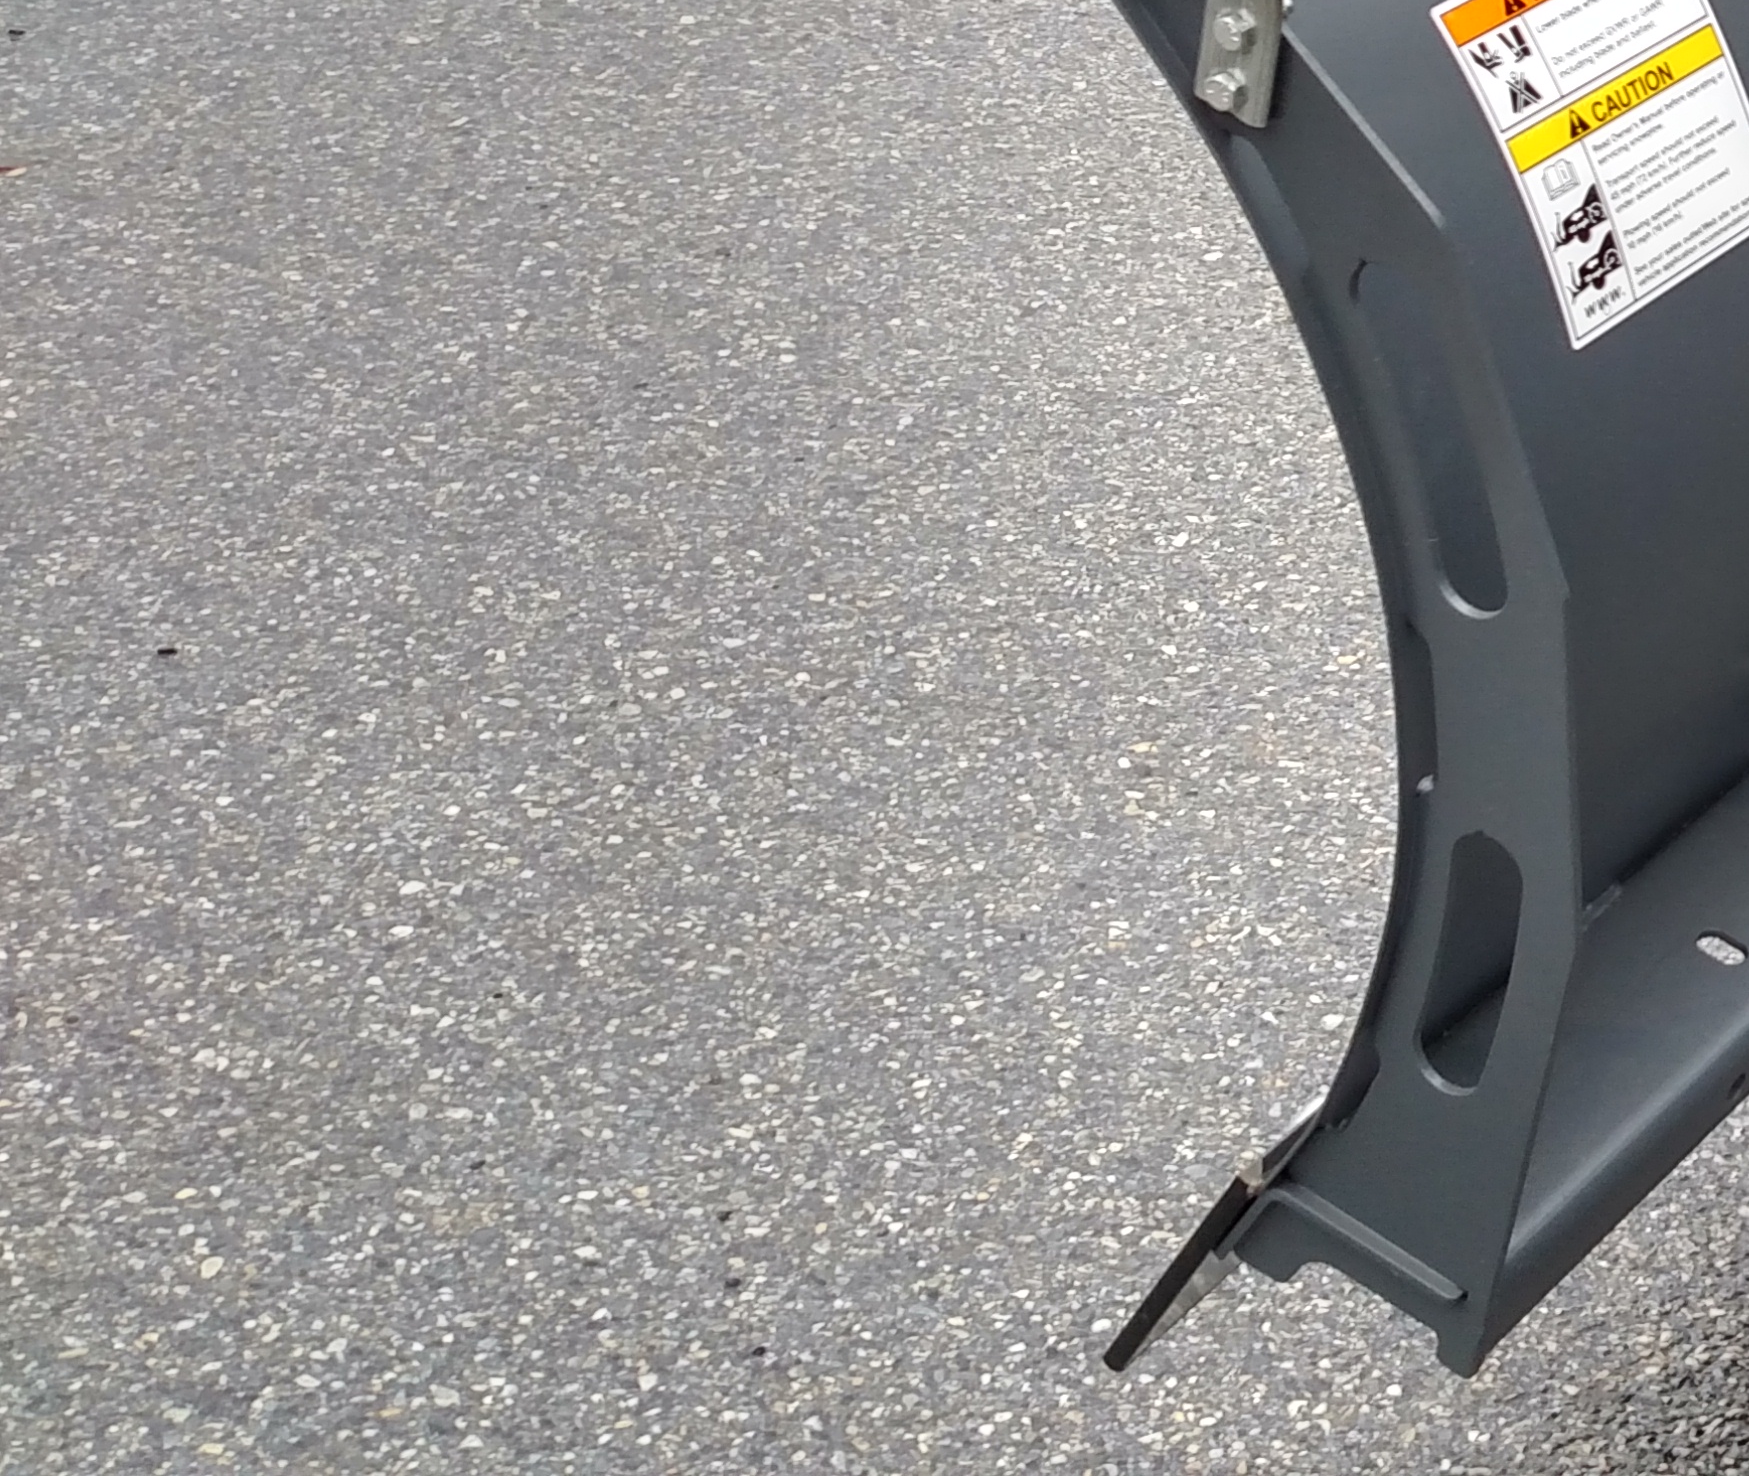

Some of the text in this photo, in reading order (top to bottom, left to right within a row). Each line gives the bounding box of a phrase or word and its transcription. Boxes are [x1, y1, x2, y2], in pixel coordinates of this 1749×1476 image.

[1536, 17, 1559, 33] Lower
[1559, 5, 1583, 21] blade
[1552, 56, 1565, 65] Do
[1565, 47, 1579, 59] not
[1579, 34, 1606, 52] exceed
[1559, 54, 1595, 78] including
[1594, 43, 1616, 59] blade
[1616, 35, 1631, 47] and
[1591, 62, 1674, 122] CAUTION
[1592, 139, 1612, 152] Read
[1639, 108, 1663, 124] Manual
[1663, 95, 1686, 110] before
[1686, 78, 1718, 97] operating
[1694, 133, 1717, 148] reduce
[1716, 120, 1736, 136] speed
[1598, 144, 1630, 166] servicing
[1639, 152, 1660, 168] speed
[1661, 138, 1683, 155] should
[1684, 130, 1695, 140] not
[1696, 116, 1719, 134] exceed
[1615, 198, 1635, 213] under
[1636, 181, 1662, 200] adverse
[1662, 168, 1681, 183] travel
[1651, 204, 1671, 221] speed
[1672, 190, 1694, 208] should
[1707, 167, 1730, 186] exceed
